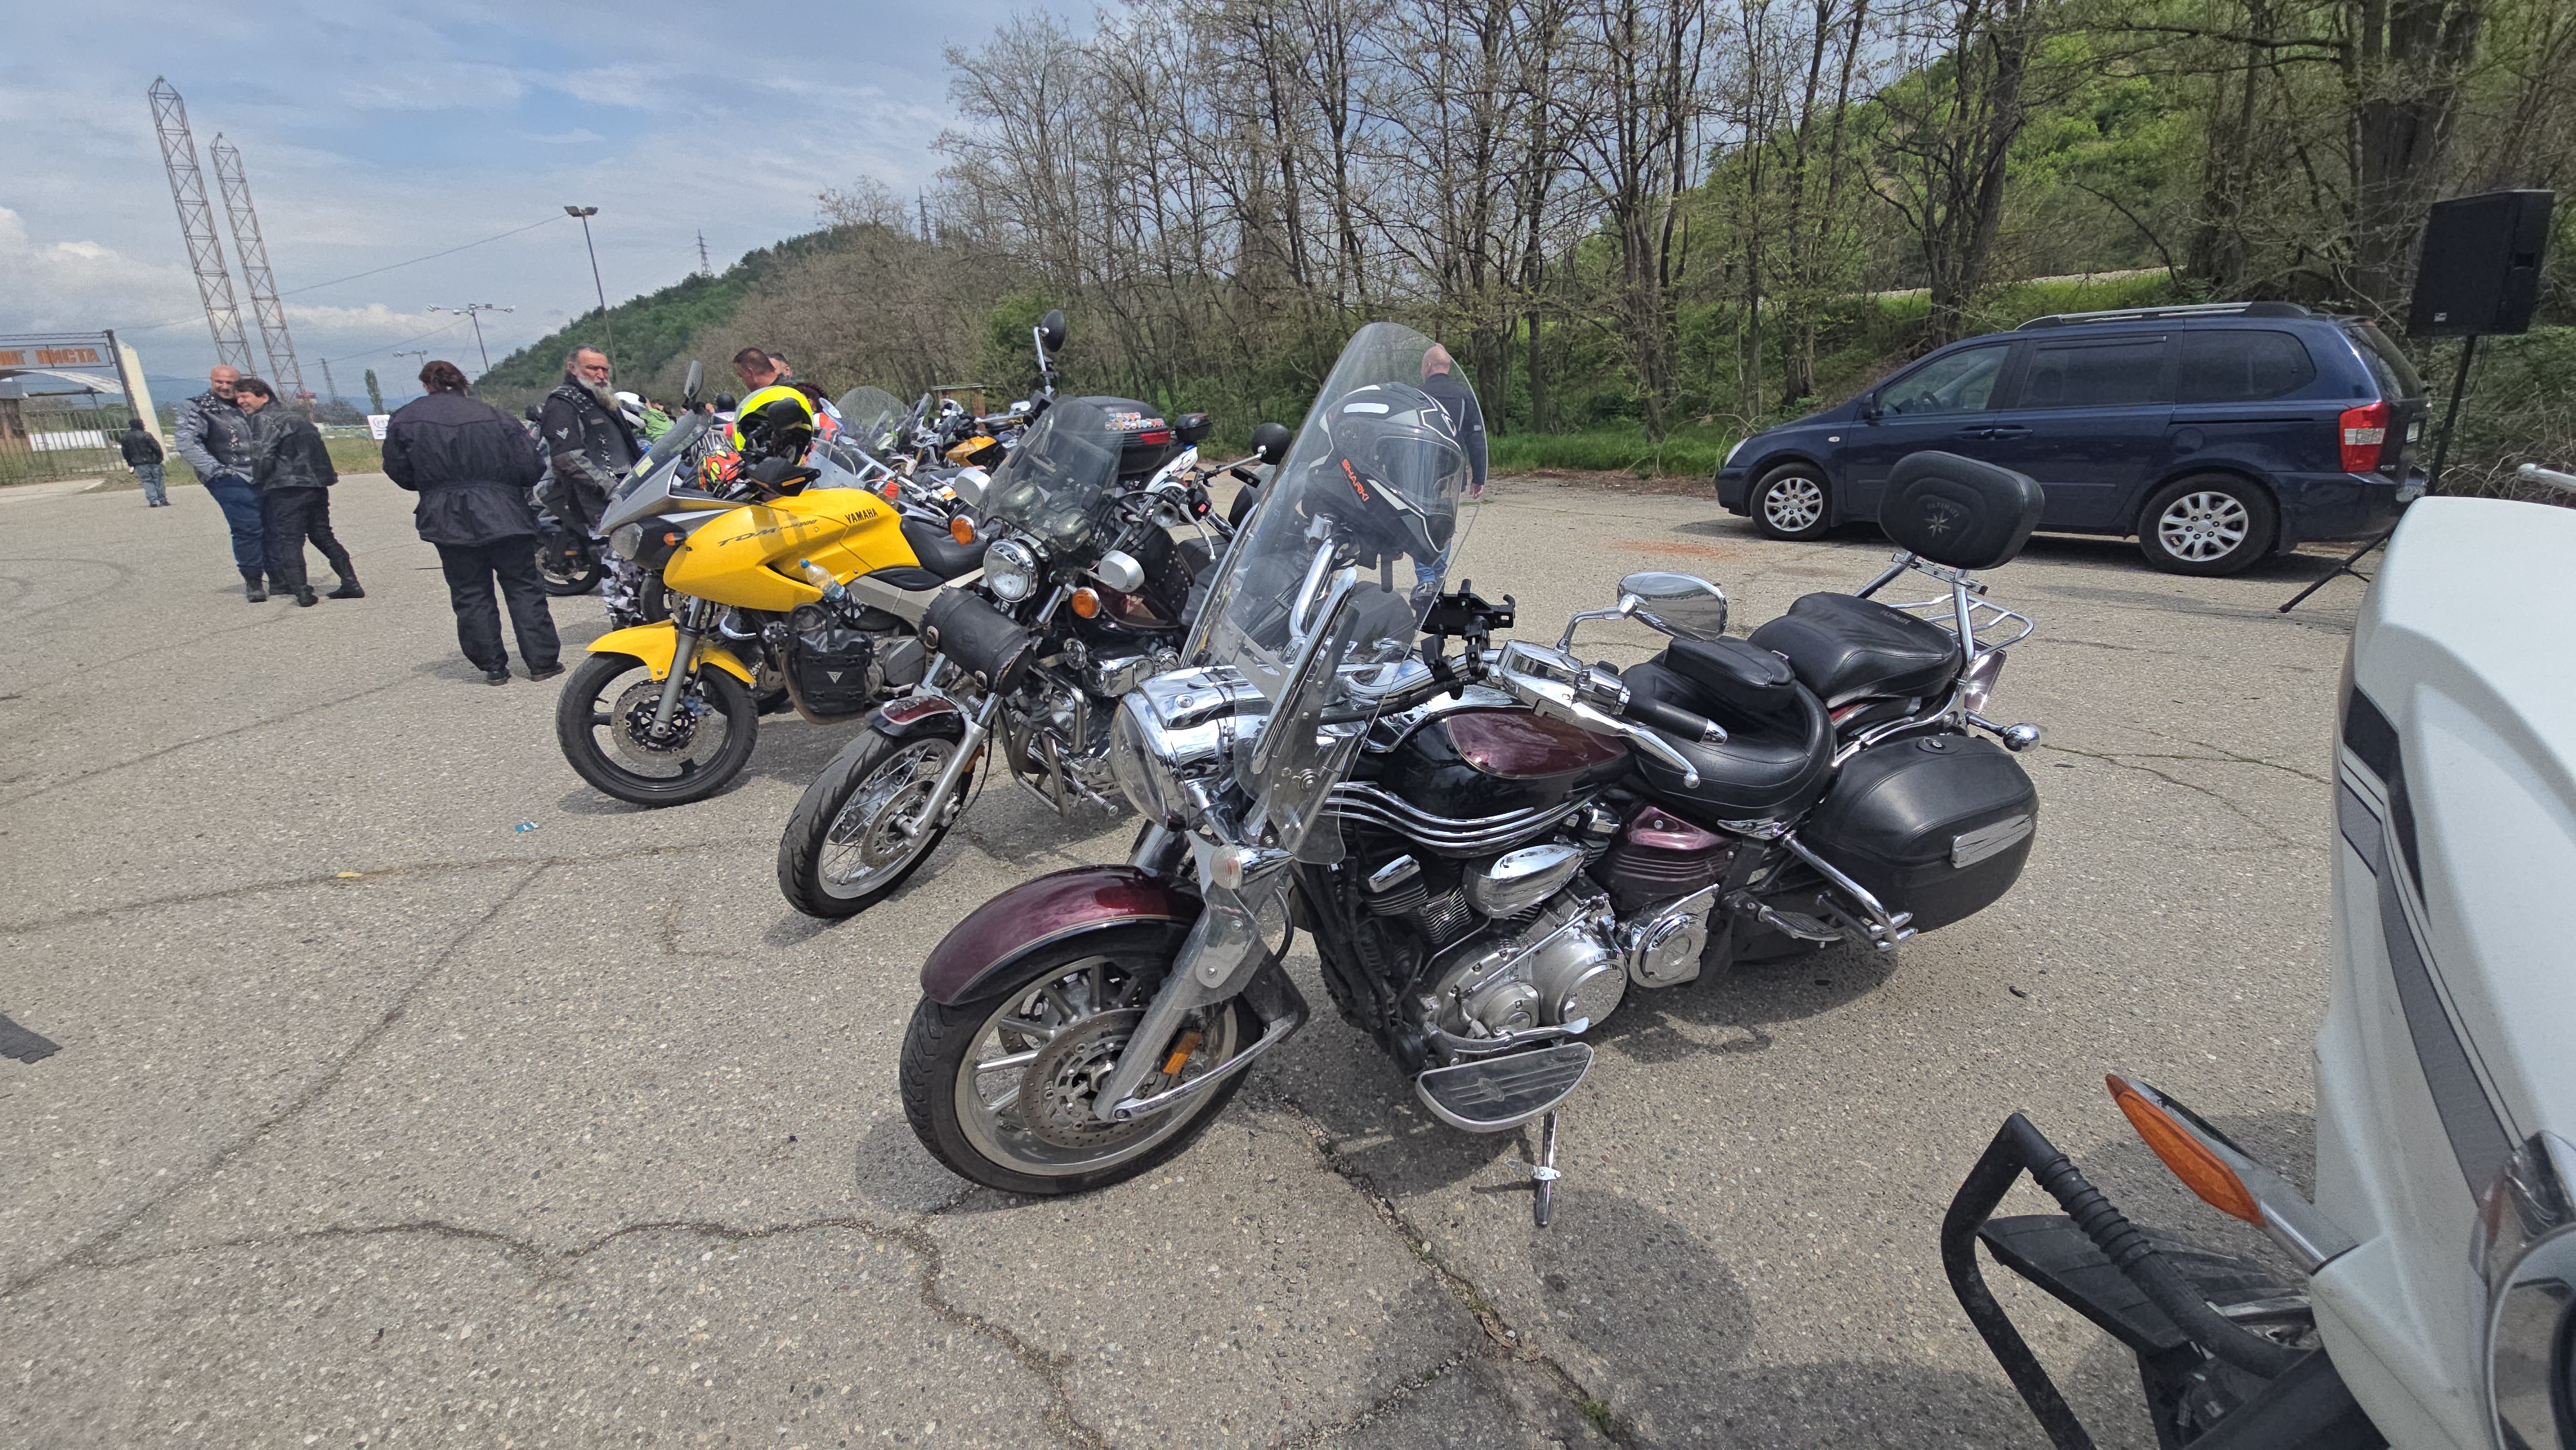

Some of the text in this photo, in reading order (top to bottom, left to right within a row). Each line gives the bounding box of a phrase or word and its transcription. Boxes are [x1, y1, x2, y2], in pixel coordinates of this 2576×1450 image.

[35, 348, 101, 364] ПИСТА
[845, 507, 878, 524] YAMAHA
[717, 527, 775, 547] TDM
